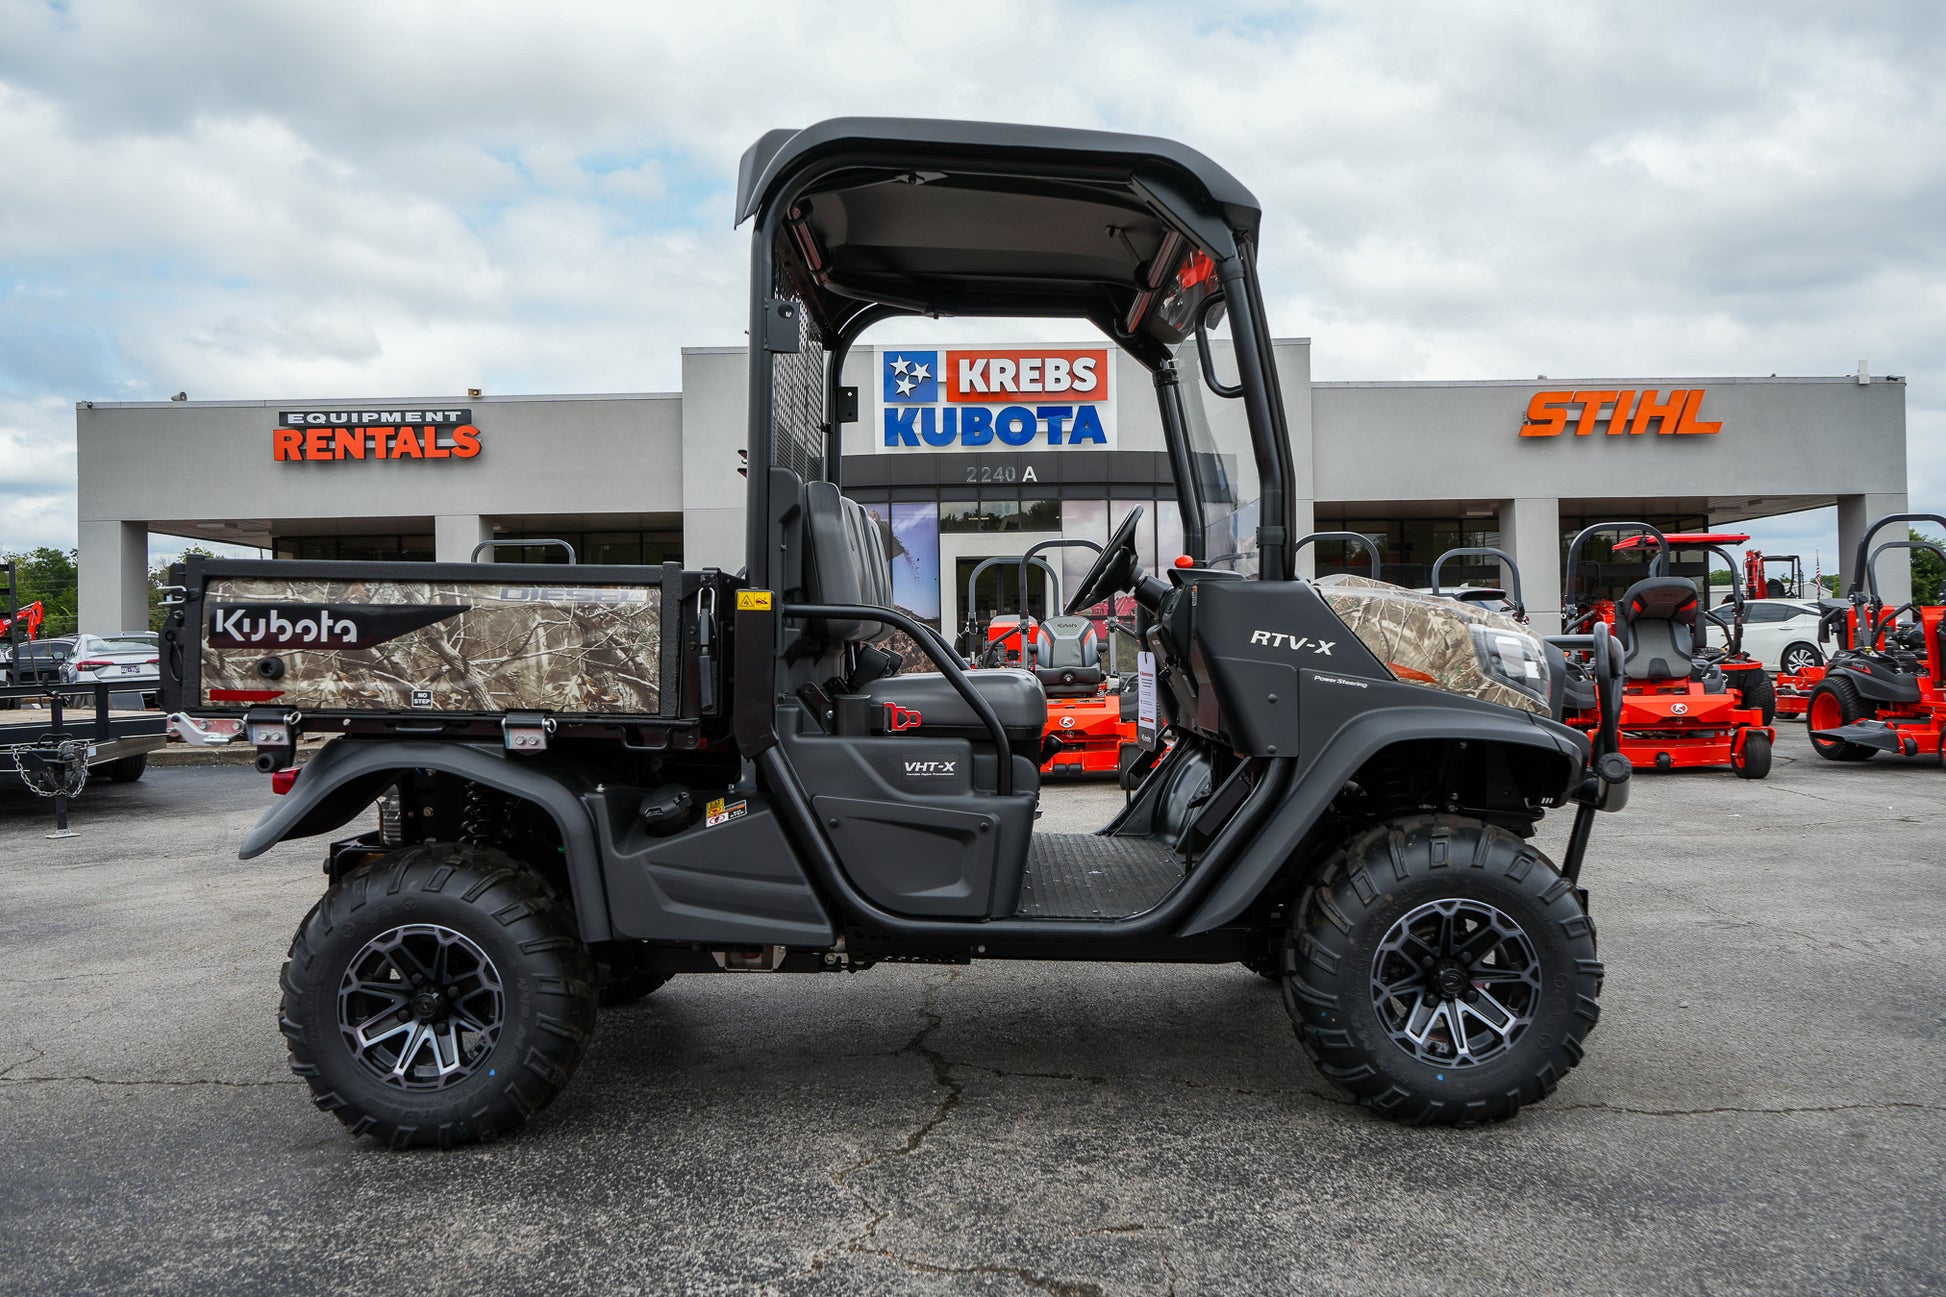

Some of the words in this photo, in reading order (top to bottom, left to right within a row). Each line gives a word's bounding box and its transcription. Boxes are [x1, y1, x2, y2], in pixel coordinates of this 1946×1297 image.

[959, 356, 1098, 393] KREBS
[287, 411, 462, 424] EQUIPMENT
[884, 405, 1108, 447] KUBOTA
[1518, 389, 1723, 437] STIHL
[273, 425, 482, 461] RENTALS
[966, 466, 1016, 483] 2240
[1022, 465, 1038, 482] A
[216, 609, 358, 643] Kubota
[1250, 630, 1337, 656] RTV-X
[1314, 675, 1337, 683] Power
[1336, 678, 1368, 689] Steering
[904, 761, 957, 772] VHT-X
